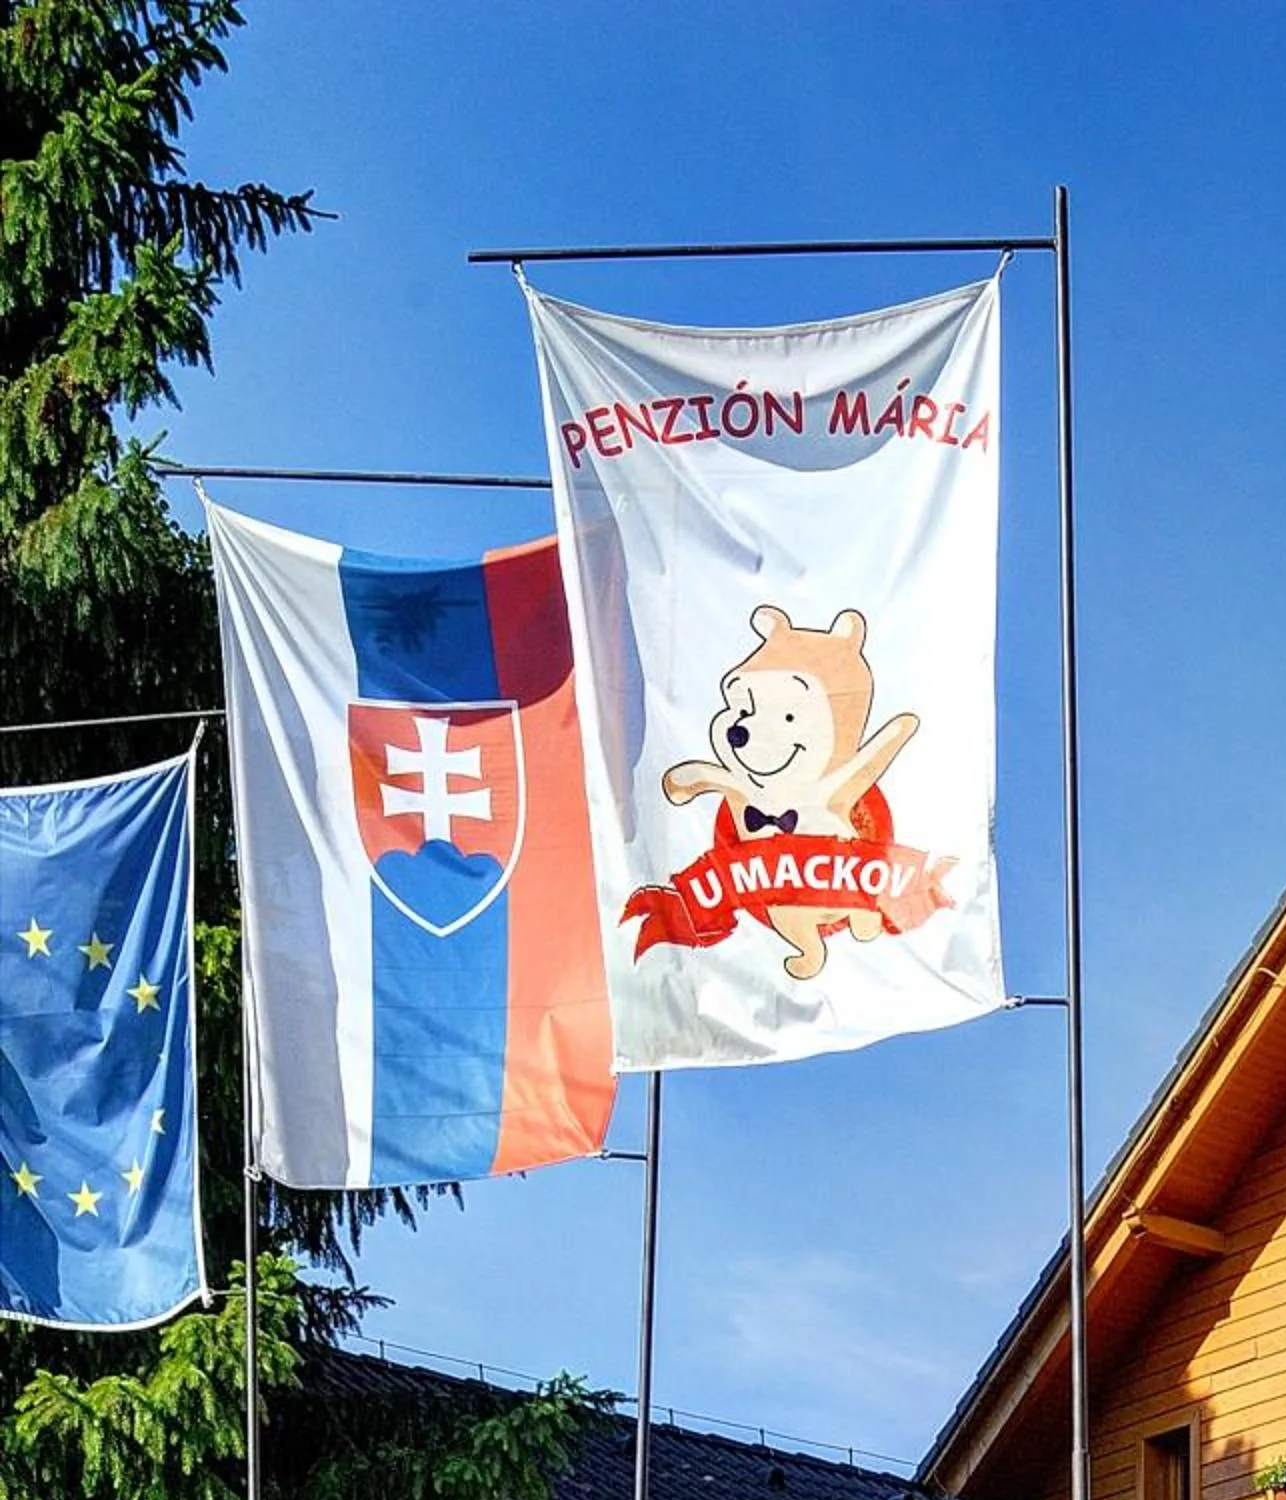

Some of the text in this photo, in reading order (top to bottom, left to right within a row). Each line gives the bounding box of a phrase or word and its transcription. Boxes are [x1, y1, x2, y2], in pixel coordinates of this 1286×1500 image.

[562, 375, 991, 469] PENZIÓN MÁRIA
[691, 853, 916, 911] U MACKOV
